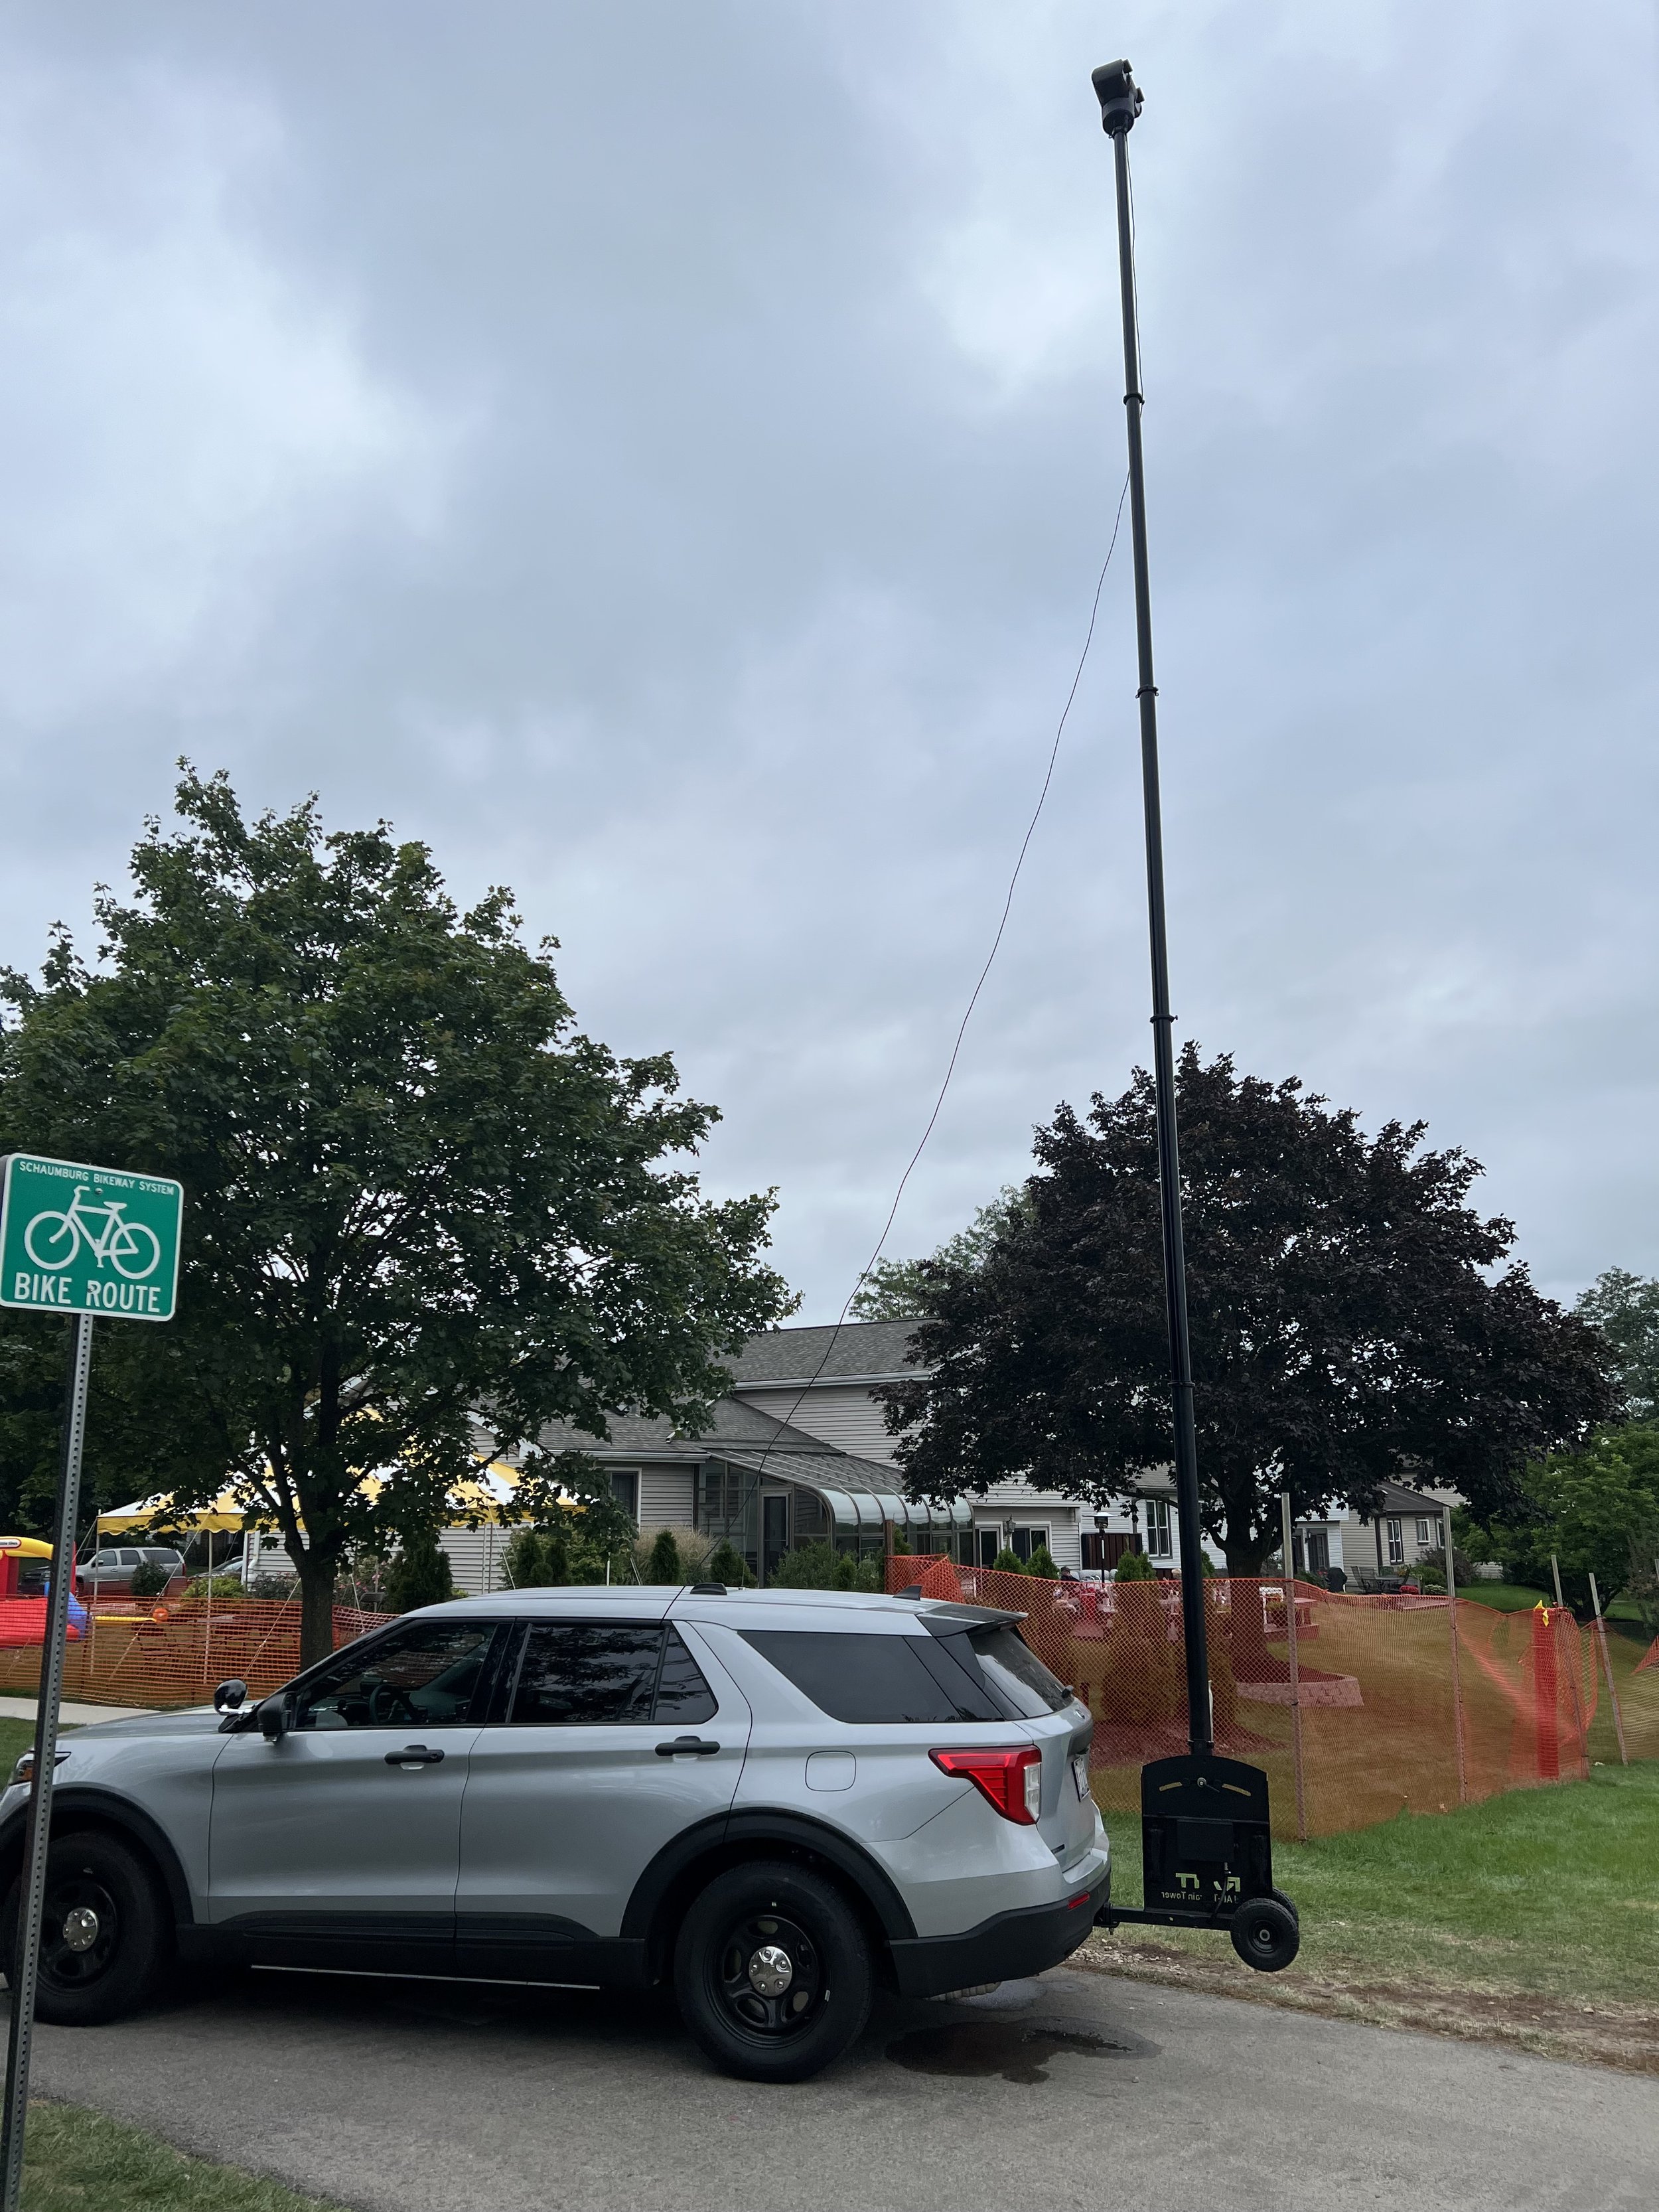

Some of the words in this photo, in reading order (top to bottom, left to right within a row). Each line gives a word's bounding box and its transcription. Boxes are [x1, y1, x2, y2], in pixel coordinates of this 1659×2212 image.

[19, 1161, 89, 1181] SCHAUMBURG
[93, 1173, 135, 1189] BIKEWAY
[139, 1181, 175, 1195] SYSTEM
[14, 1272, 72, 1305] BIKE
[86, 1280, 161, 1313] ROUTE
